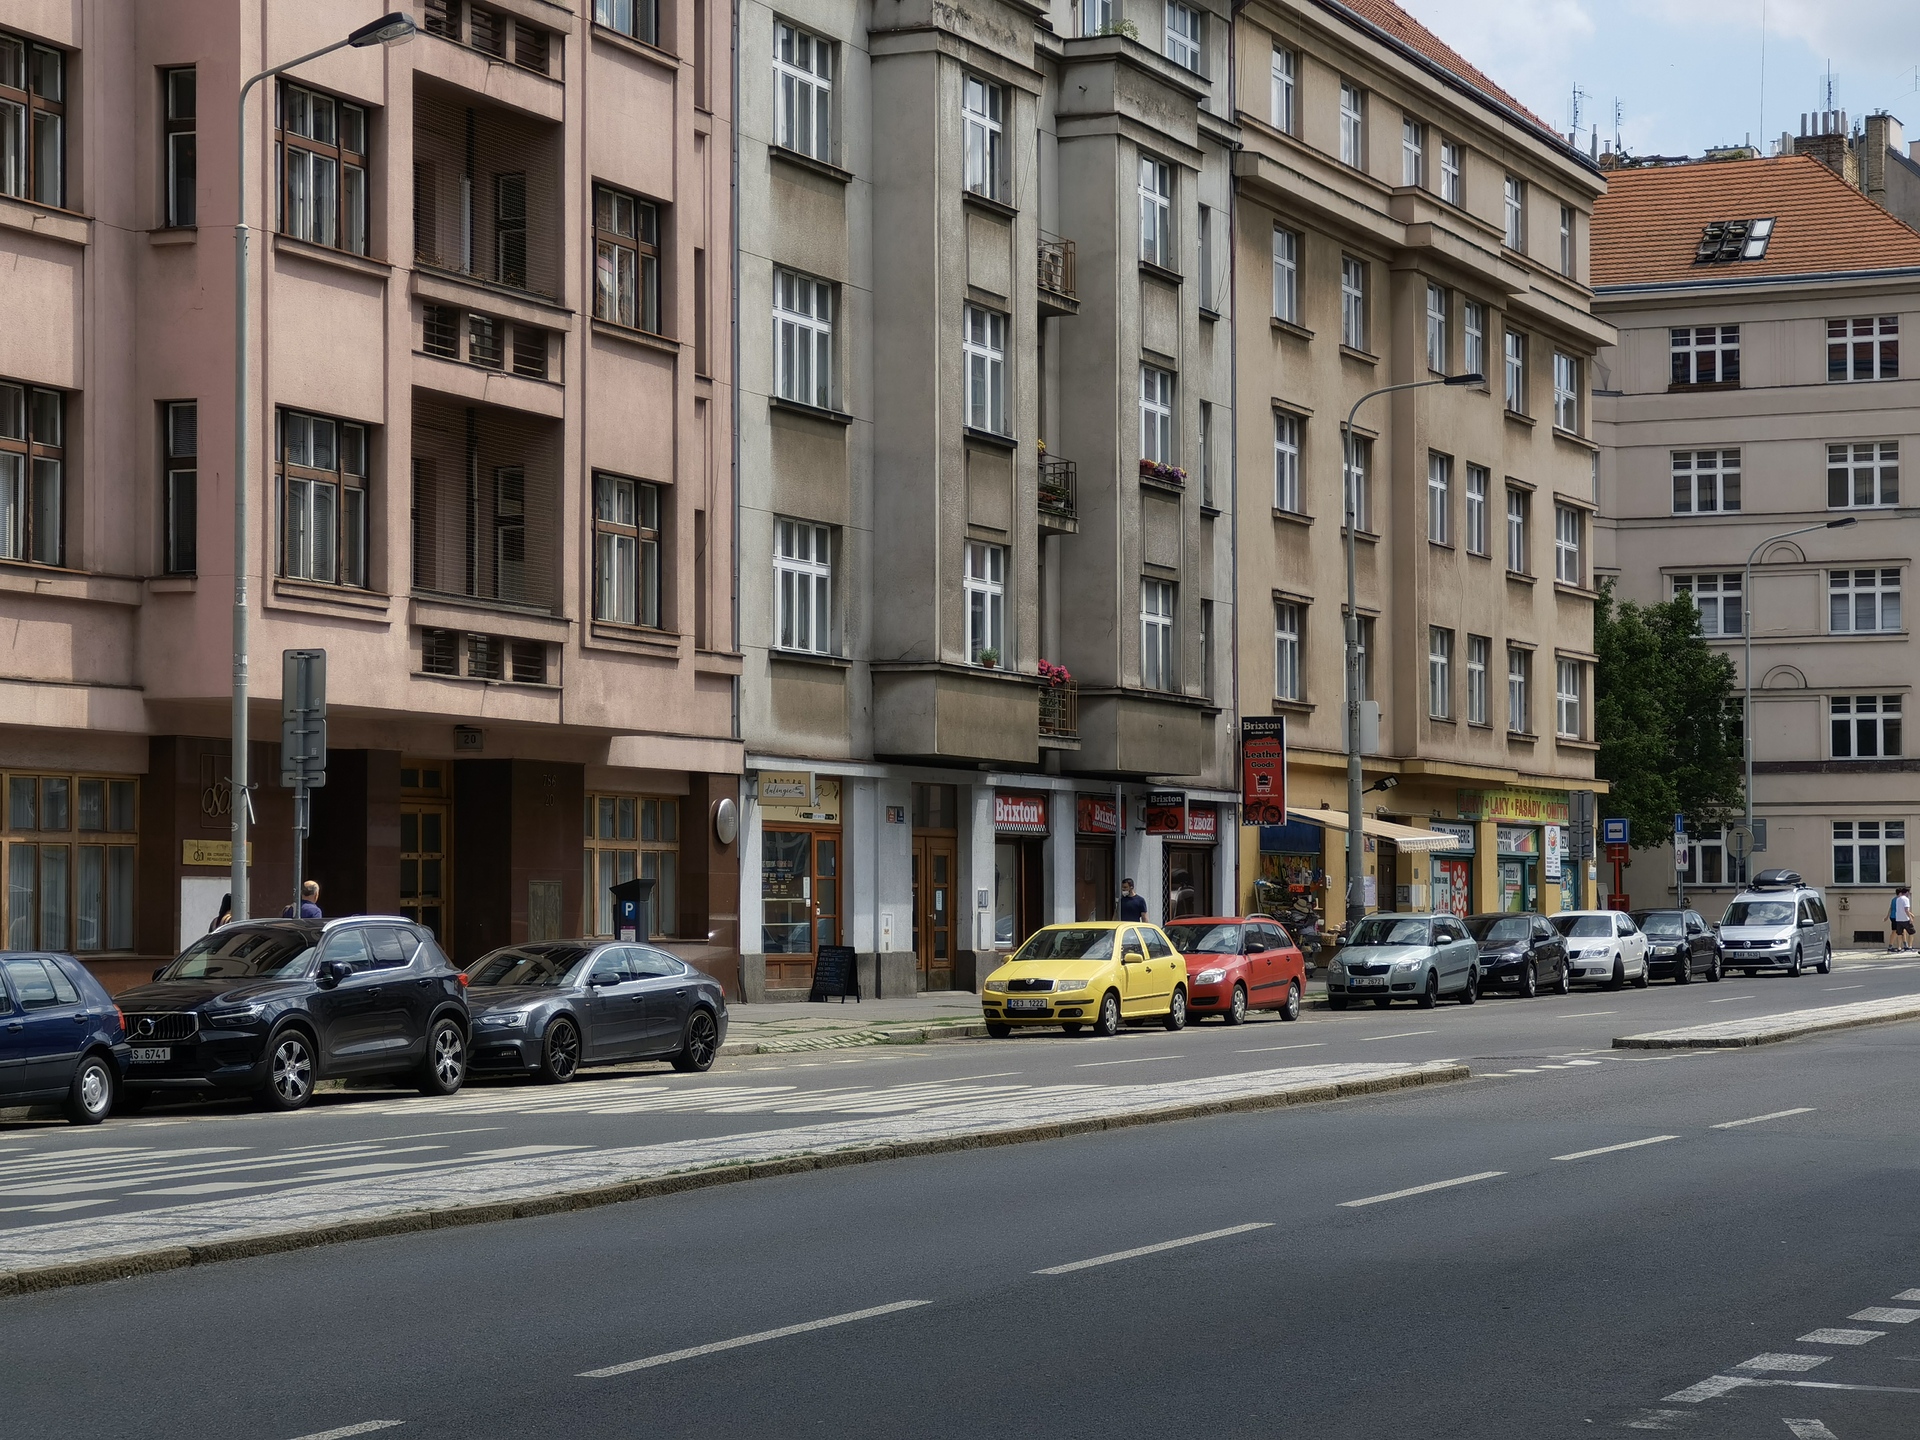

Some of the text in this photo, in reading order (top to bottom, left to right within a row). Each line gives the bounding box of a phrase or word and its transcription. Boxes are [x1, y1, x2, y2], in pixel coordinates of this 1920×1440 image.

[1243, 721, 1281, 731] Brixton
[463, 734, 477, 744] 20
[1245, 750, 1281, 759] Leather
[1150, 794, 1182, 803] Brixton
[995, 797, 1039, 823] Brixton
[1490, 796, 1510, 816] LAKY
[1515, 796, 1542, 819] FASÁDY
[1094, 804, 1117, 826] Brixto
[1193, 814, 1215, 831] ZBOŽÍ
[625, 902, 634, 917] P
[144, 1049, 166, 1060] 6741
